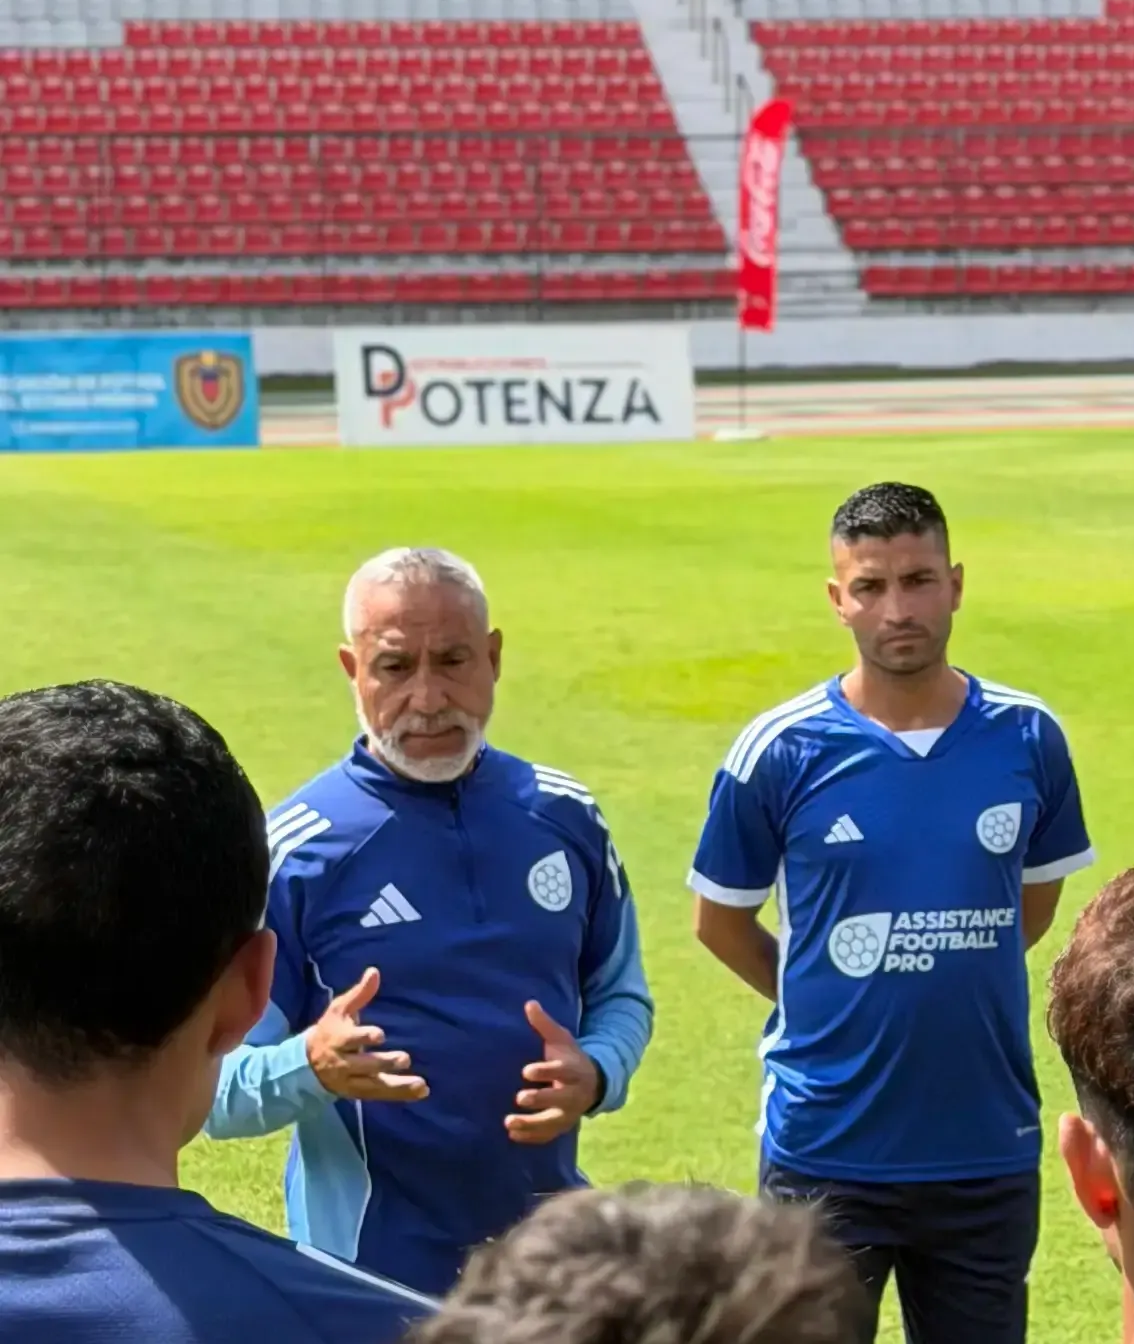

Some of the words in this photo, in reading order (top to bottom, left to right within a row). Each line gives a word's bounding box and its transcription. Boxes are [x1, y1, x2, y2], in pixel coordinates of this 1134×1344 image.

[893, 908, 1015, 930] ASSISTANCE
[889, 929, 998, 951] FOOTBALL
[884, 953, 935, 972] PRO
